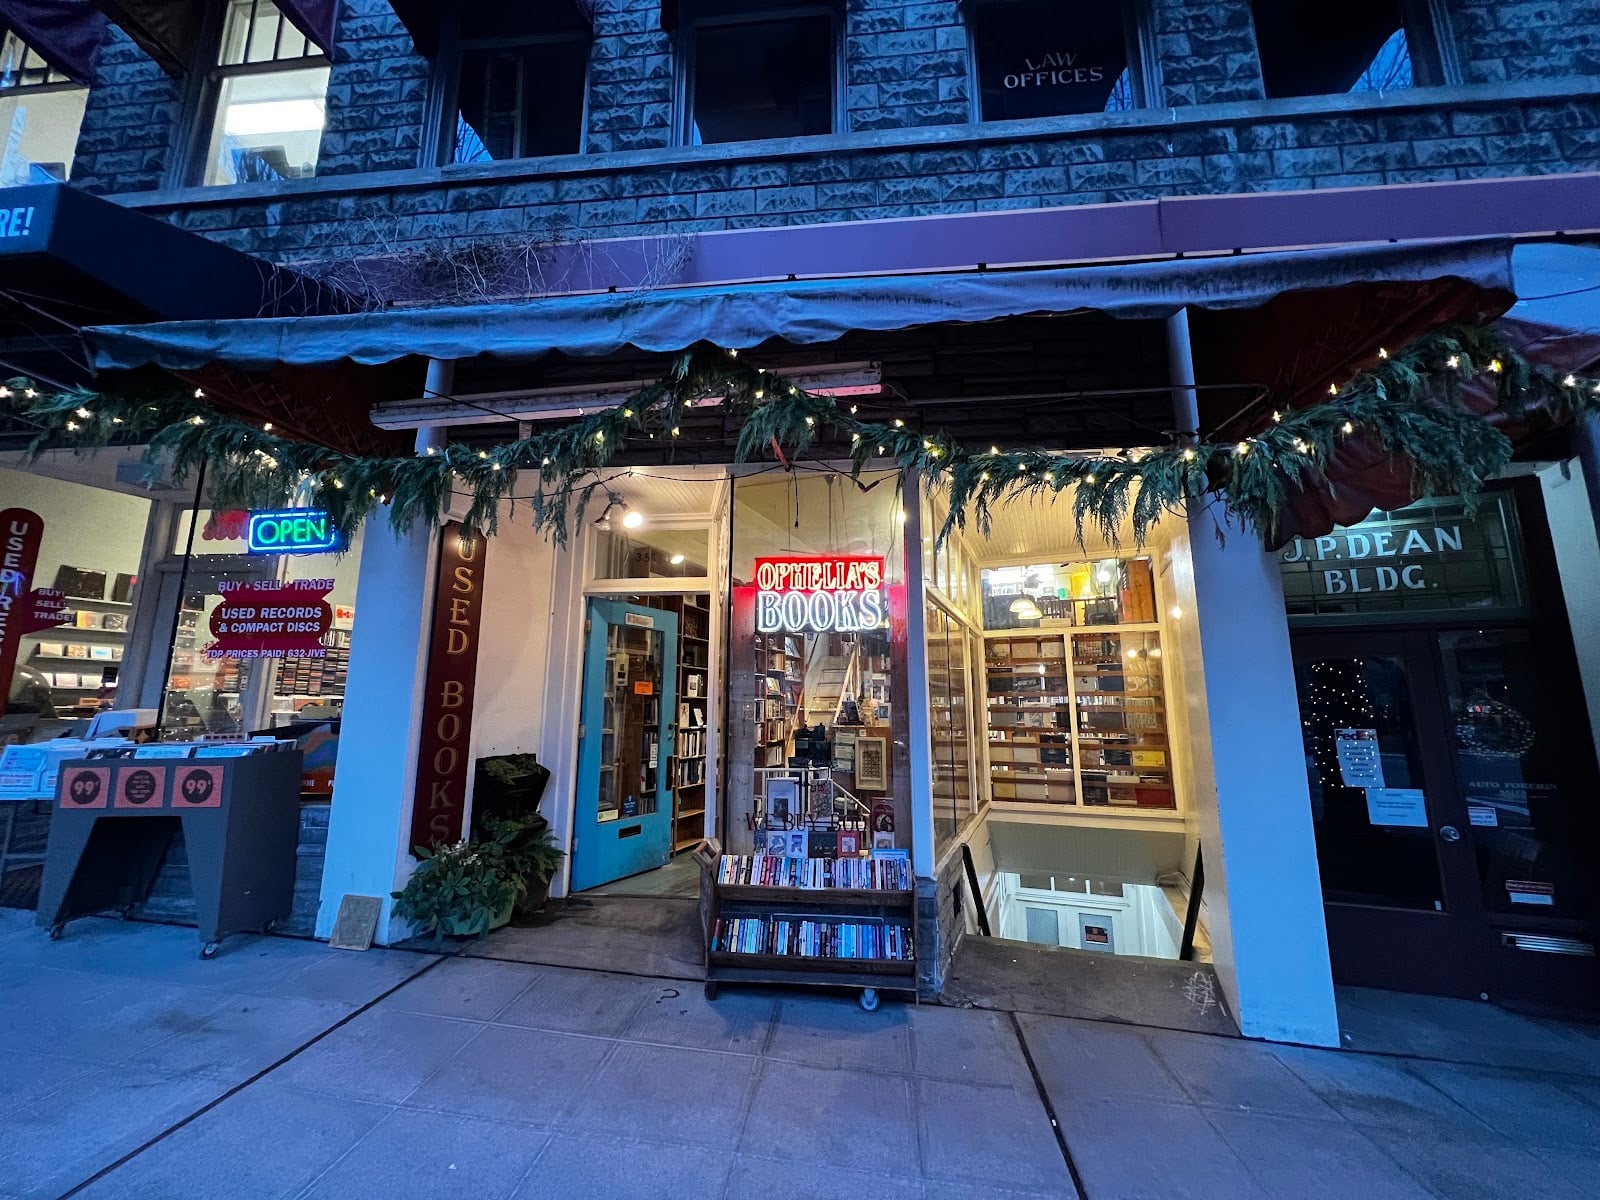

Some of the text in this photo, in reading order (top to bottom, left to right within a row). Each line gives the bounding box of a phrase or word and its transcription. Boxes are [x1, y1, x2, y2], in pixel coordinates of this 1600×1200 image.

[1024, 51, 1078, 71] LAW
[1003, 67, 1104, 89] OFFICES
[256, 518, 326, 545] OPEN
[0, 520, 29, 584] USED
[218, 579, 335, 592] BUY SELL TRADE
[757, 561, 882, 591] OPHELIA'S
[1323, 564, 1439, 595] BLDG.
[447, 536, 477, 655] USED
[33, 610, 75, 622] TRADE!
[221, 606, 323, 619] USED RECORDS
[757, 590, 882, 633] BOOKS
[218, 622, 321, 633] & COMPACT DISCS
[207, 648, 327, 659] TOP PRICES PAID! 632-JIVE
[427, 679, 465, 848] BOOKS
[783, 812, 820, 832] BUY
